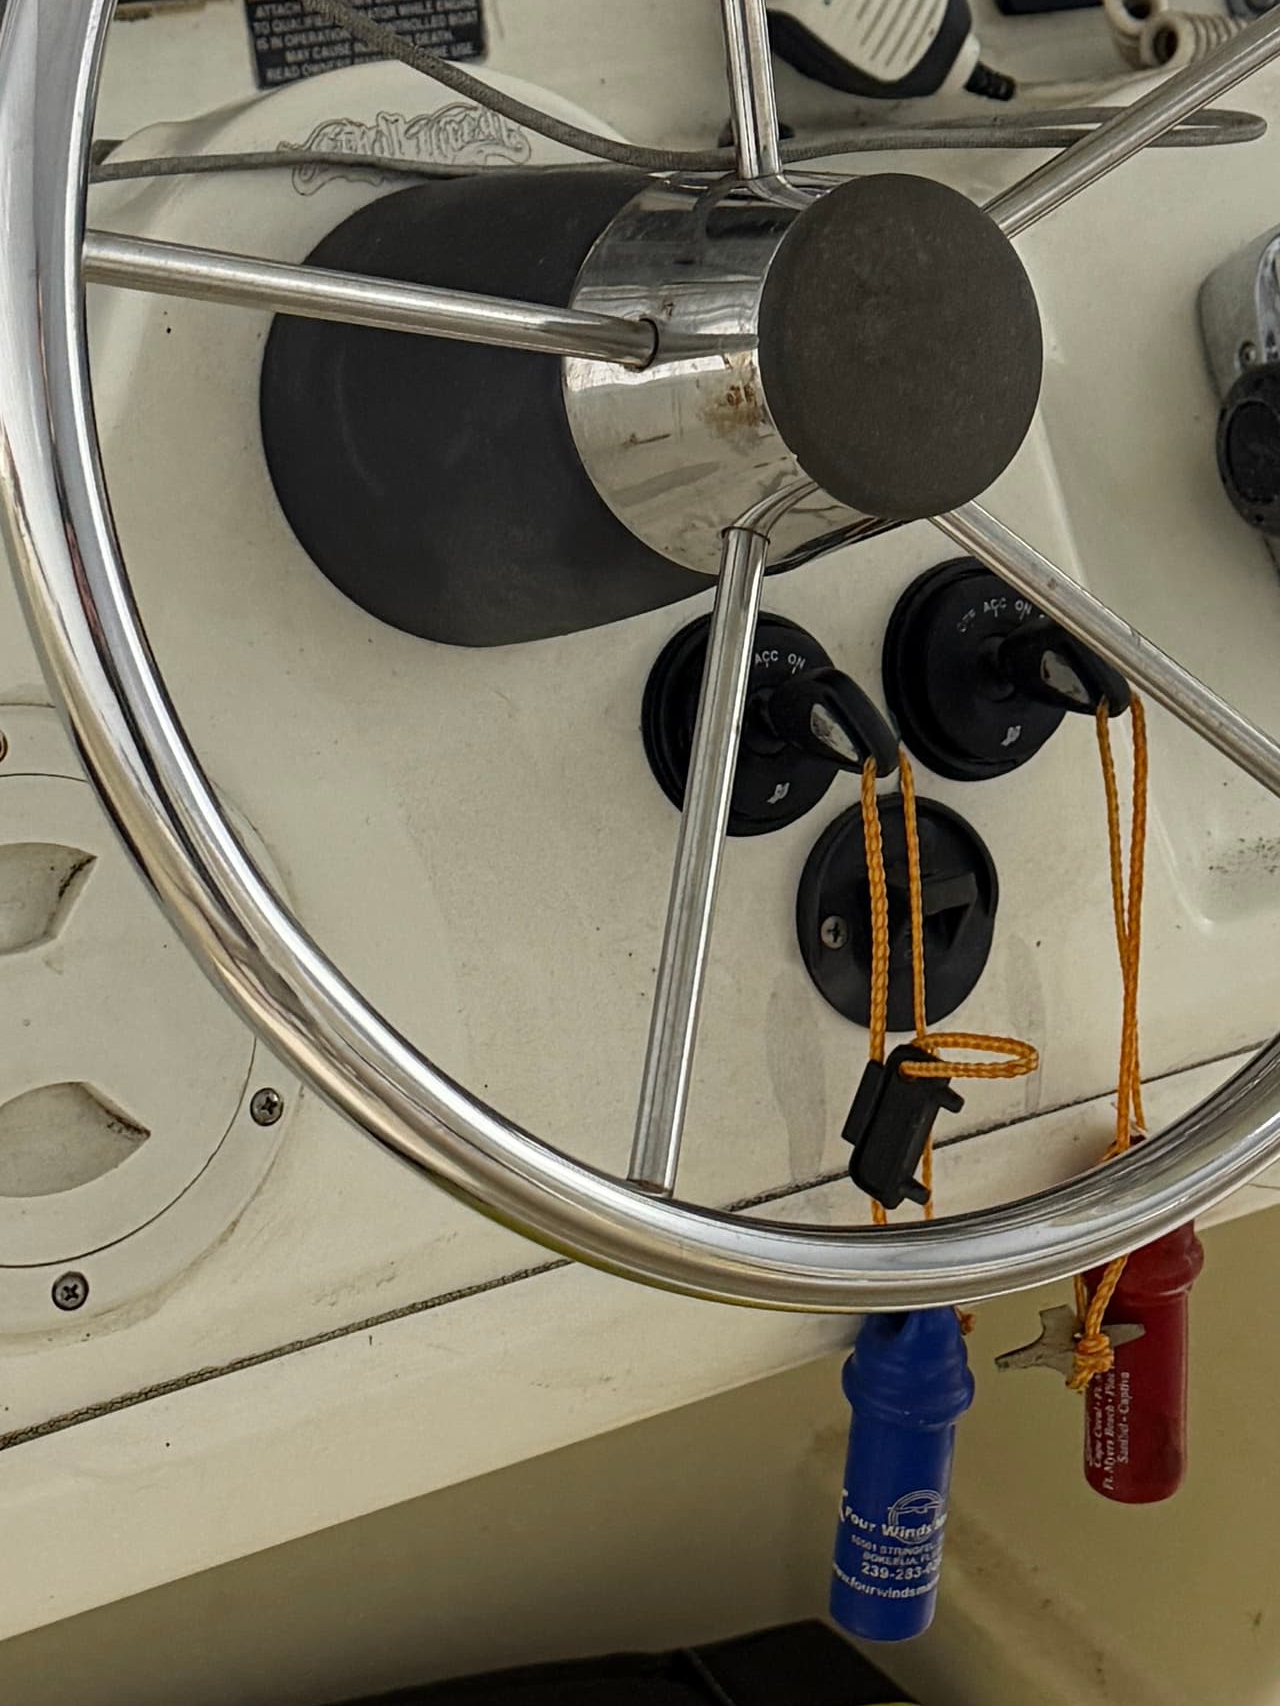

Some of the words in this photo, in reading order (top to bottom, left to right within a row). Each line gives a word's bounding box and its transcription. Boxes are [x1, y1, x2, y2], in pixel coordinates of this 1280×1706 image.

[982, 597, 1007, 614] ACC
[1015, 599, 1033, 617] ON
[754, 650, 780, 665] ACC
[787, 653, 807, 671] ON
[1119, 1372, 1133, 1413] Captiva
[845, 1505, 877, 1533] Four
[880, 1523, 933, 1540] Winds
